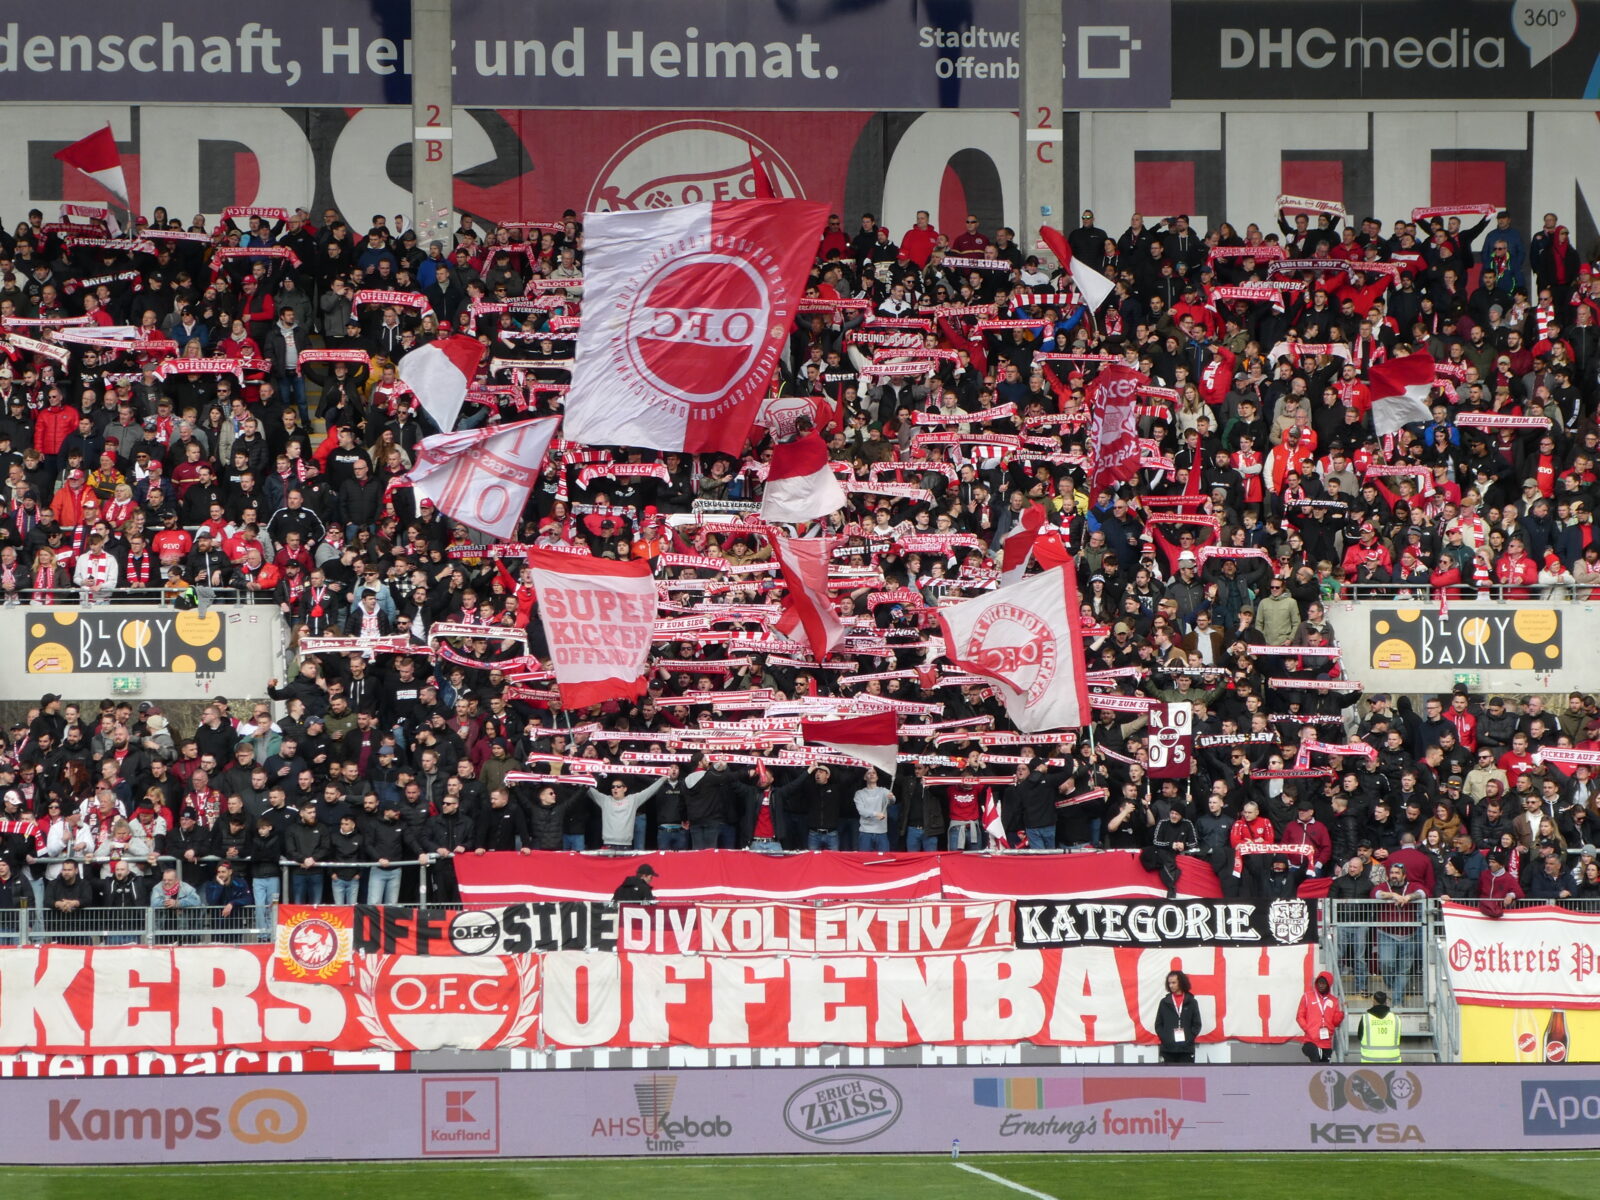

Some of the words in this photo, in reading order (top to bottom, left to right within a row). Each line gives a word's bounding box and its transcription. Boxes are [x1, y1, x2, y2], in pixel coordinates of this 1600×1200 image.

[0, 22, 302, 87] denschaft,
[321, 27, 457, 76] He
[475, 27, 585, 77] und
[606, 27, 839, 79] Heimat.
[426, 105, 441, 127] 2
[1038, 107, 1052, 128] 2
[425, 140, 442, 162] B
[1036, 142, 1053, 164] C
[227, 208, 281, 217] OFFENBACH
[74, 238, 106, 246] FREUND
[82, 275, 113, 288] BAYER
[1273, 281, 1306, 290] FREUND
[361, 292, 415, 303] OFFENBACH
[1220, 288, 1272, 297] OFFENBACH
[852, 332, 885, 343] FREUND
[177, 361, 234, 371] OFFENBACH
[825, 373, 855, 382] BAYER
[1026, 414, 1088, 425] OFFENBACH
[1458, 416, 1492, 424] KICKERS
[833, 546, 865, 557] BAYER
[870, 544, 890, 553] OFC
[1216, 547, 1244, 555] OFC
[666, 554, 723, 567] OFFENBACH
[667, 620, 685, 629] ZUM
[687, 618, 704, 627] SIEG
[856, 703, 925, 713] LEVERKUSEN
[1100, 698, 1115, 706] AUF
[1118, 699, 1137, 708] ZUM
[1150, 709, 1163, 728] K
[713, 721, 770, 730] KOLLEKTIV
[773, 721, 784, 730] 71
[994, 735, 1047, 745] KOLLEKTIV
[1200, 734, 1245, 746] ULTRAS
[1251, 732, 1274, 742] LEV
[682, 742, 741, 750] KOLLEKTIV
[744, 742, 757, 750] 71
[637, 753, 692, 763] KOLLEKTIV
[1173, 745, 1186, 764] 5
[1576, 753, 1593, 762] AUF
[586, 763, 642, 773] KOLLEKTIV
[644, 766, 656, 775] 71
[354, 904, 449, 954] OFF
[503, 901, 619, 953] SIDE
[623, 907, 698, 953] DIV
[700, 905, 952, 952] KOLLEKTIV
[963, 900, 1012, 948] 71
[1018, 903, 1262, 944] KATEGORIE
[453, 925, 498, 939] O.F.C.
[1449, 938, 1560, 974] Ostkreis
[390, 977, 510, 1012] O.F.C.
[542, 945, 1308, 1046] OFFENBACH
[1377, 1027, 1388, 1035] 100
[815, 1081, 862, 1104] ERICH
[800, 1088, 887, 1130] ZEISS
[49, 1098, 221, 1149] Kamps
[657, 1113, 733, 1139] Kebab
[999, 1112, 1097, 1144] Ernsting's
[1103, 1107, 1184, 1140] family
[431, 1128, 490, 1142] Kaufland
[1310, 1122, 1426, 1144] KEYSA
[646, 1134, 685, 1151] time
